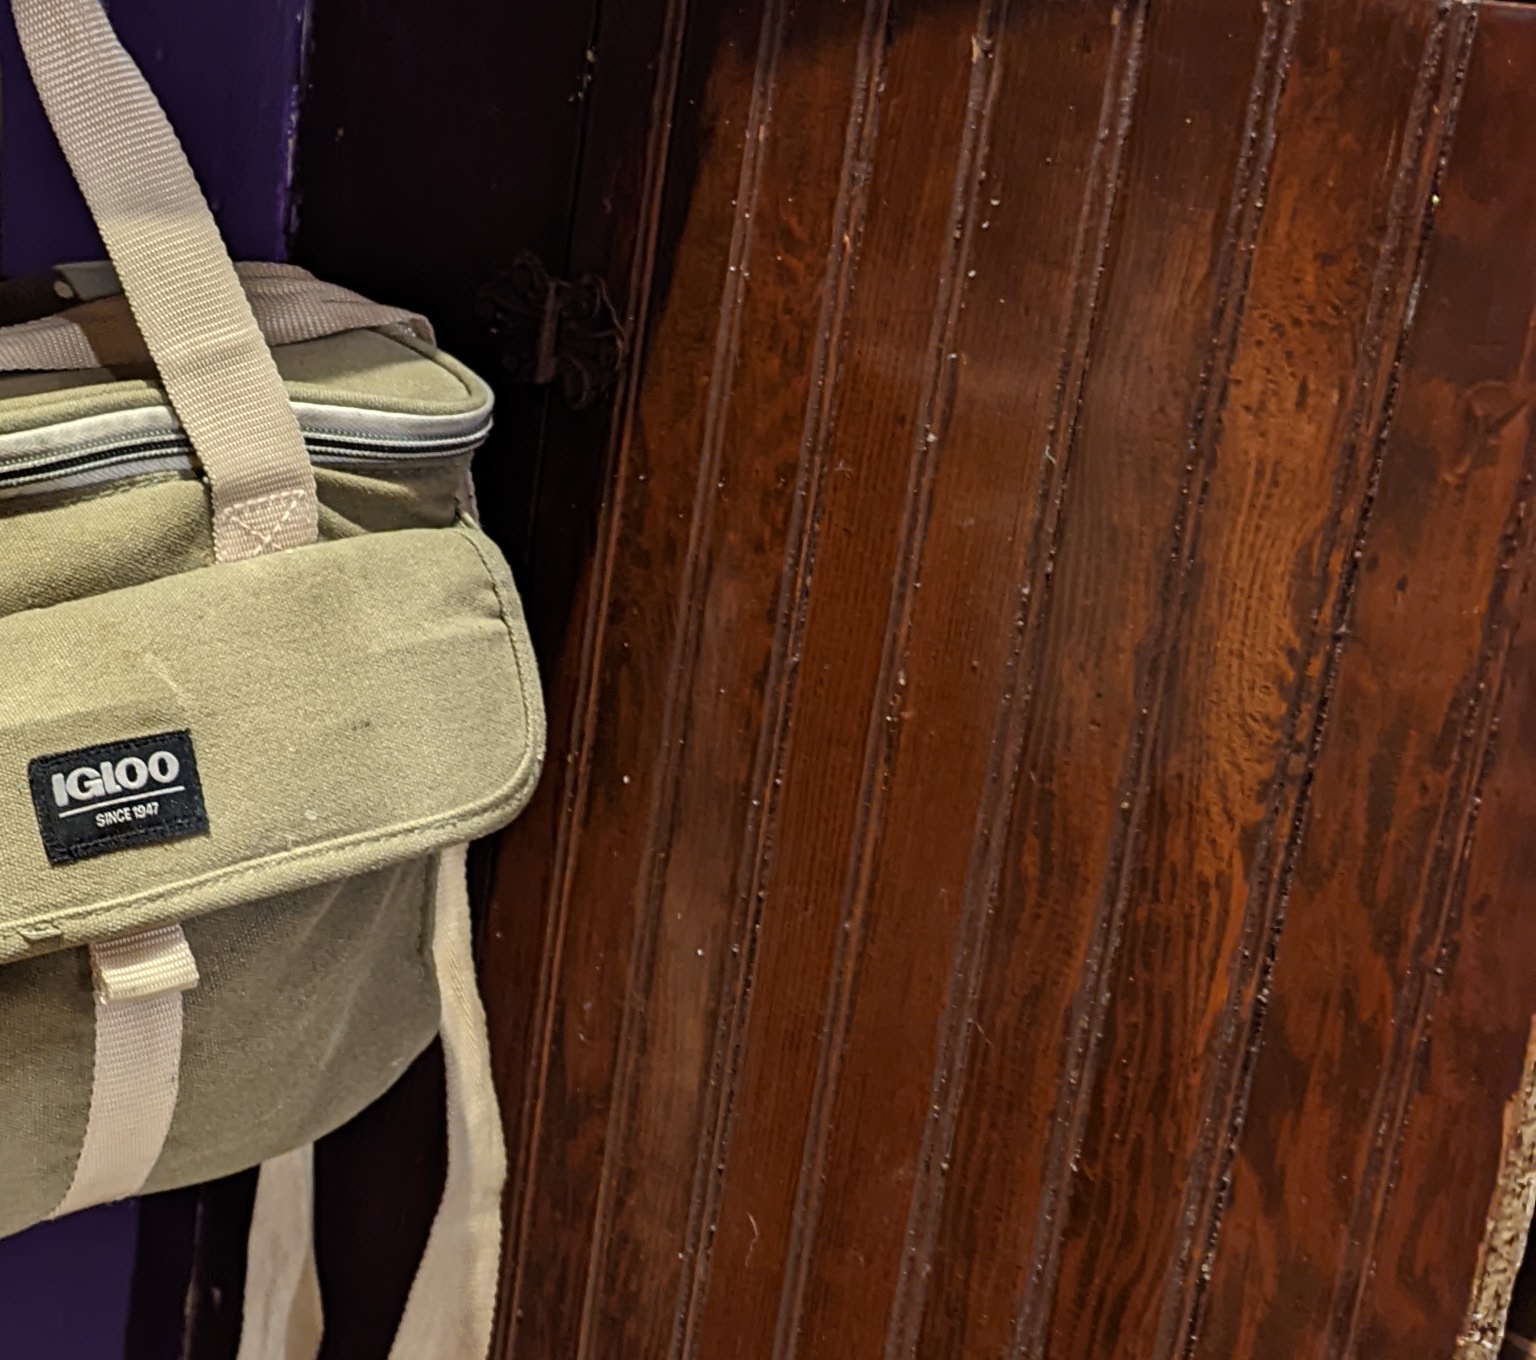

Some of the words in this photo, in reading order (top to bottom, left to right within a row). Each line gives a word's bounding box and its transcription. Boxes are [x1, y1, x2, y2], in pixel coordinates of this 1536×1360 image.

[50, 750, 181, 809] IGLOO
[94, 808, 134, 829] SINCE
[132, 800, 161, 821] 1947
